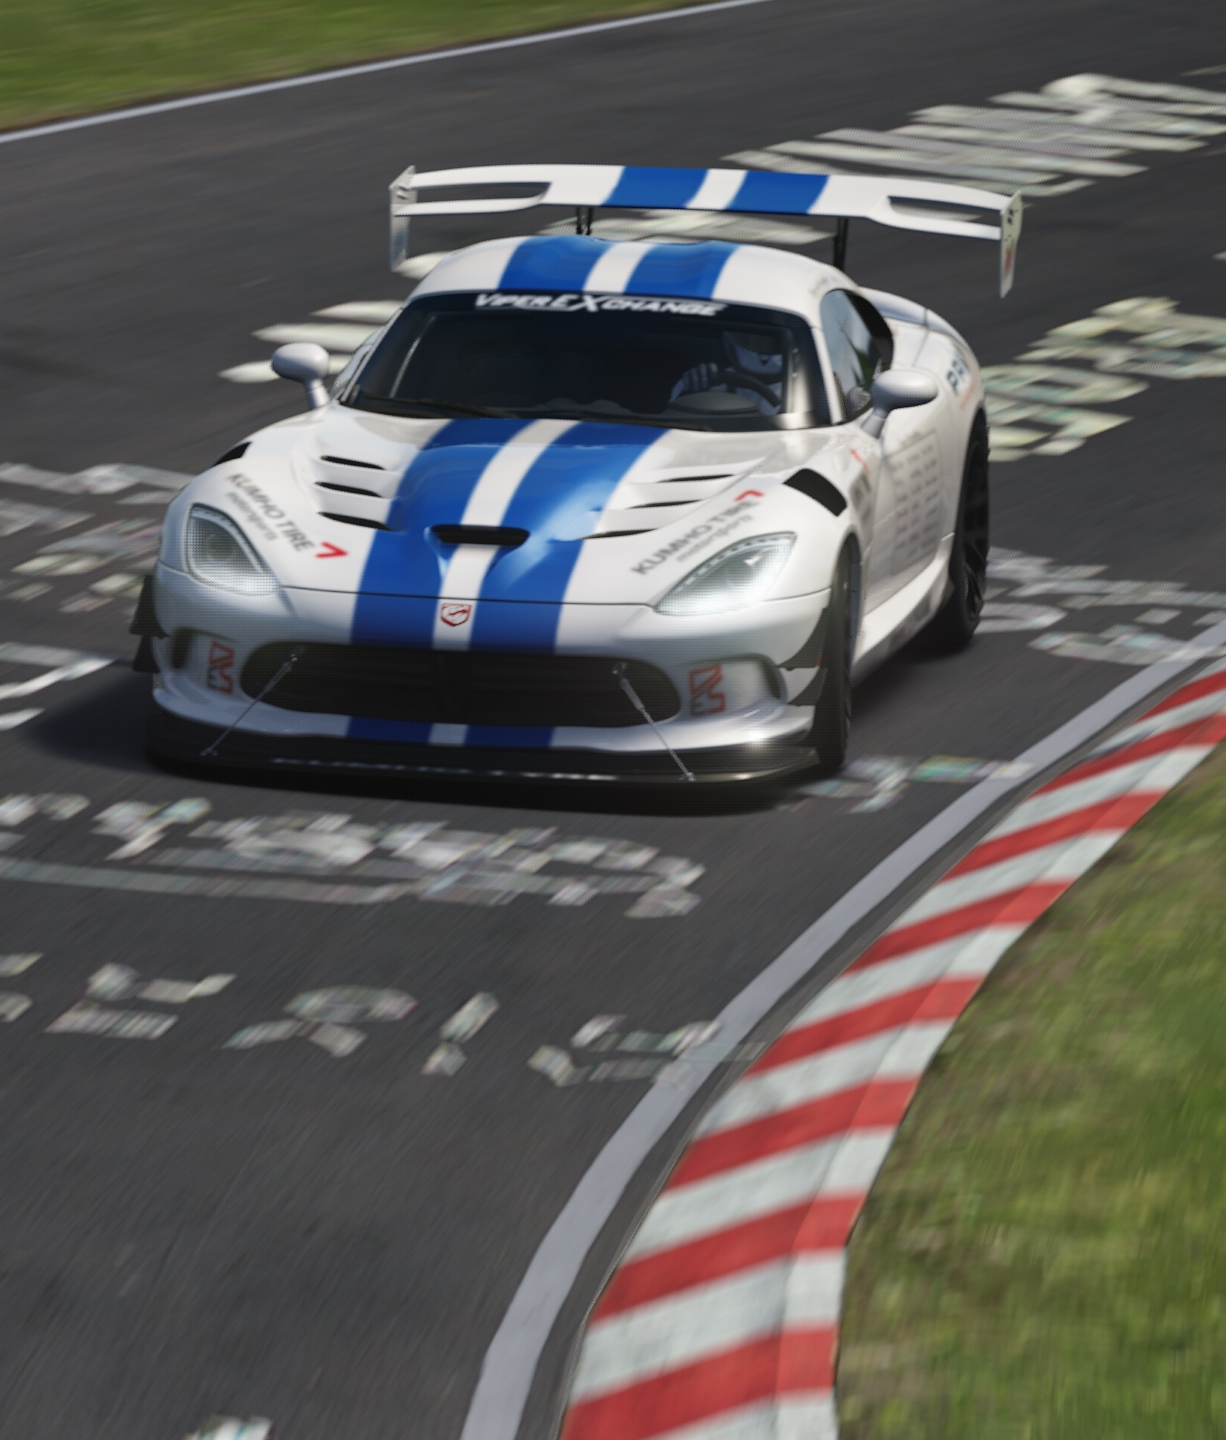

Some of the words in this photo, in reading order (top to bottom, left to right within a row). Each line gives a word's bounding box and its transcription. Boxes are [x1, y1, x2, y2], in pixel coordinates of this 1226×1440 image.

[227, 473, 285, 519] KUMHO
[276, 518, 315, 552] TIRE
[631, 524, 712, 575] KUMHO
